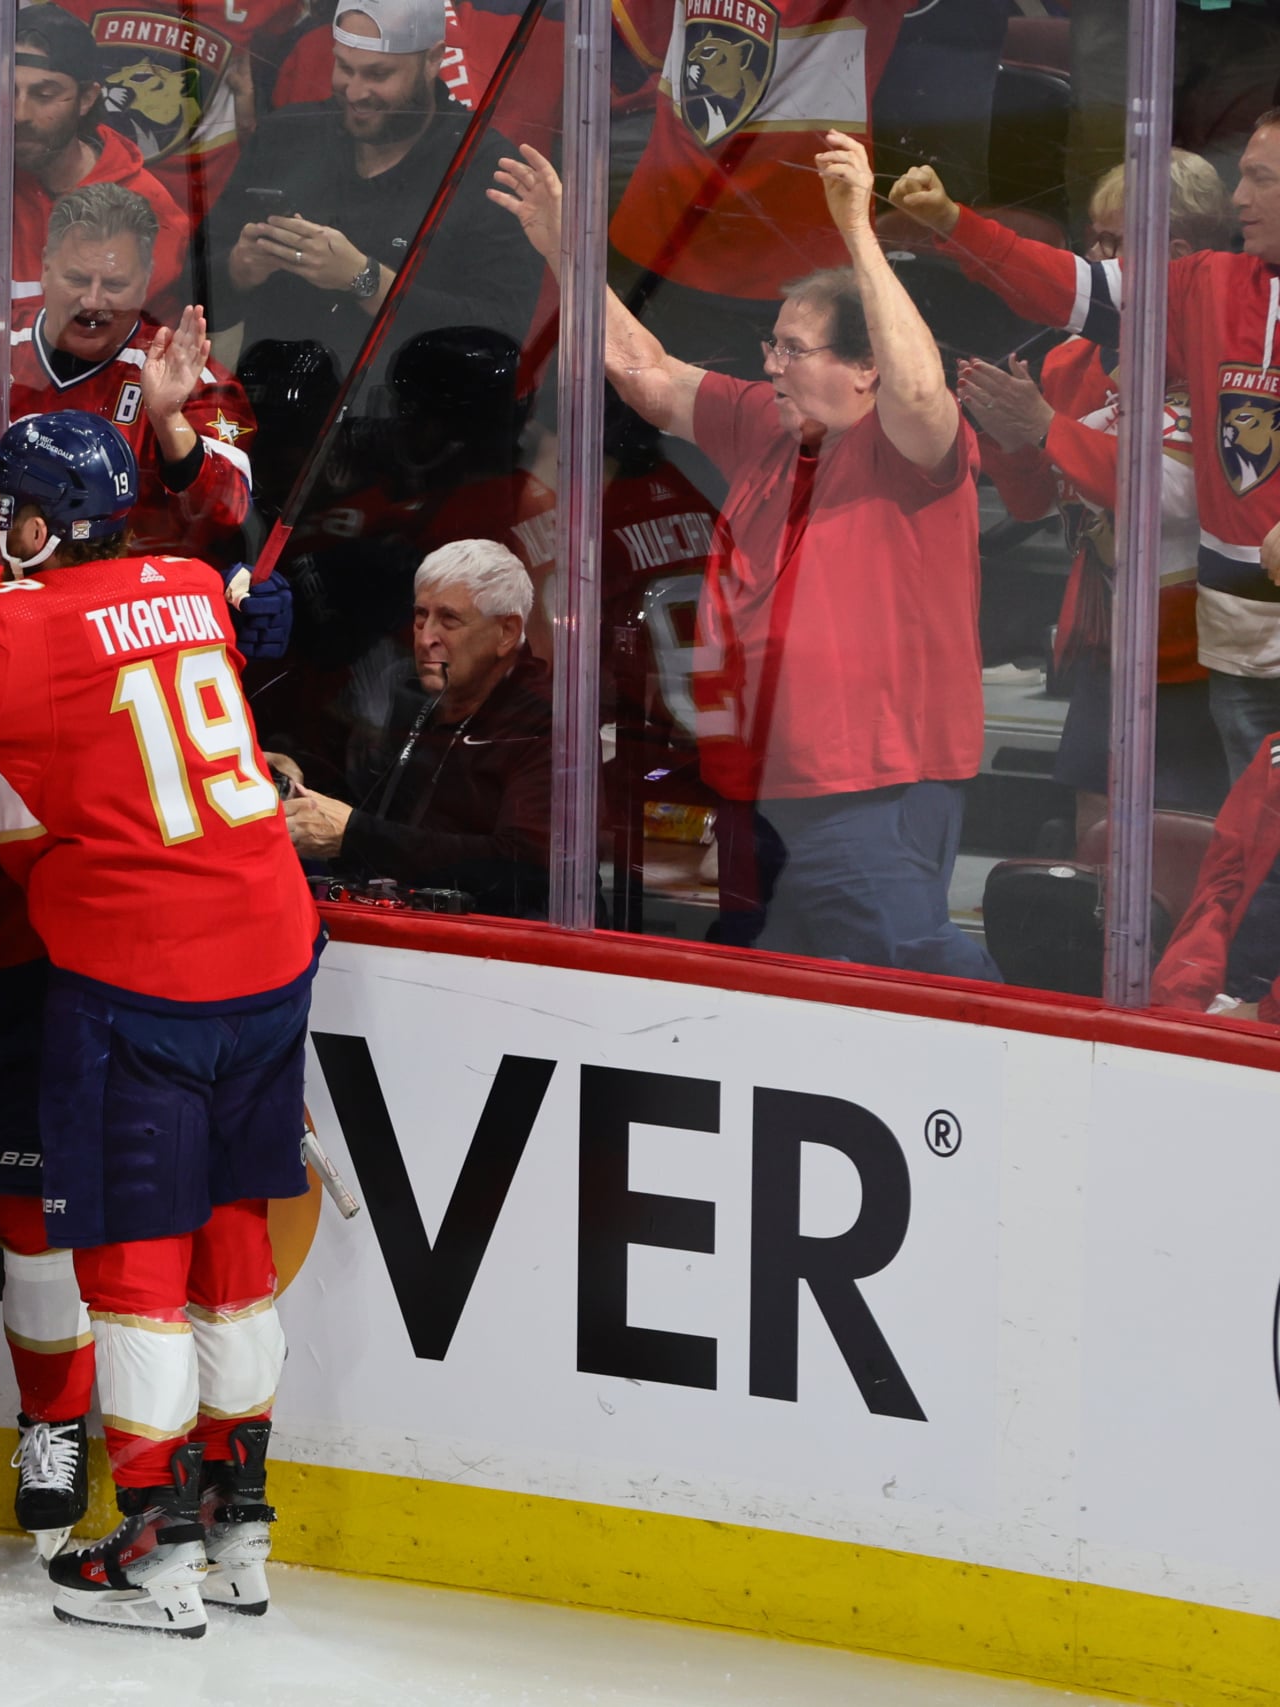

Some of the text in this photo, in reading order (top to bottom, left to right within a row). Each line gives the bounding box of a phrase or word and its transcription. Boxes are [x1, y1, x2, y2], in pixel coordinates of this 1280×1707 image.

[104, 20, 219, 63] PANTHERS
[114, 473, 129, 496] 19
[85, 594, 225, 656] TKACHUK
[110, 643, 279, 847] 19
